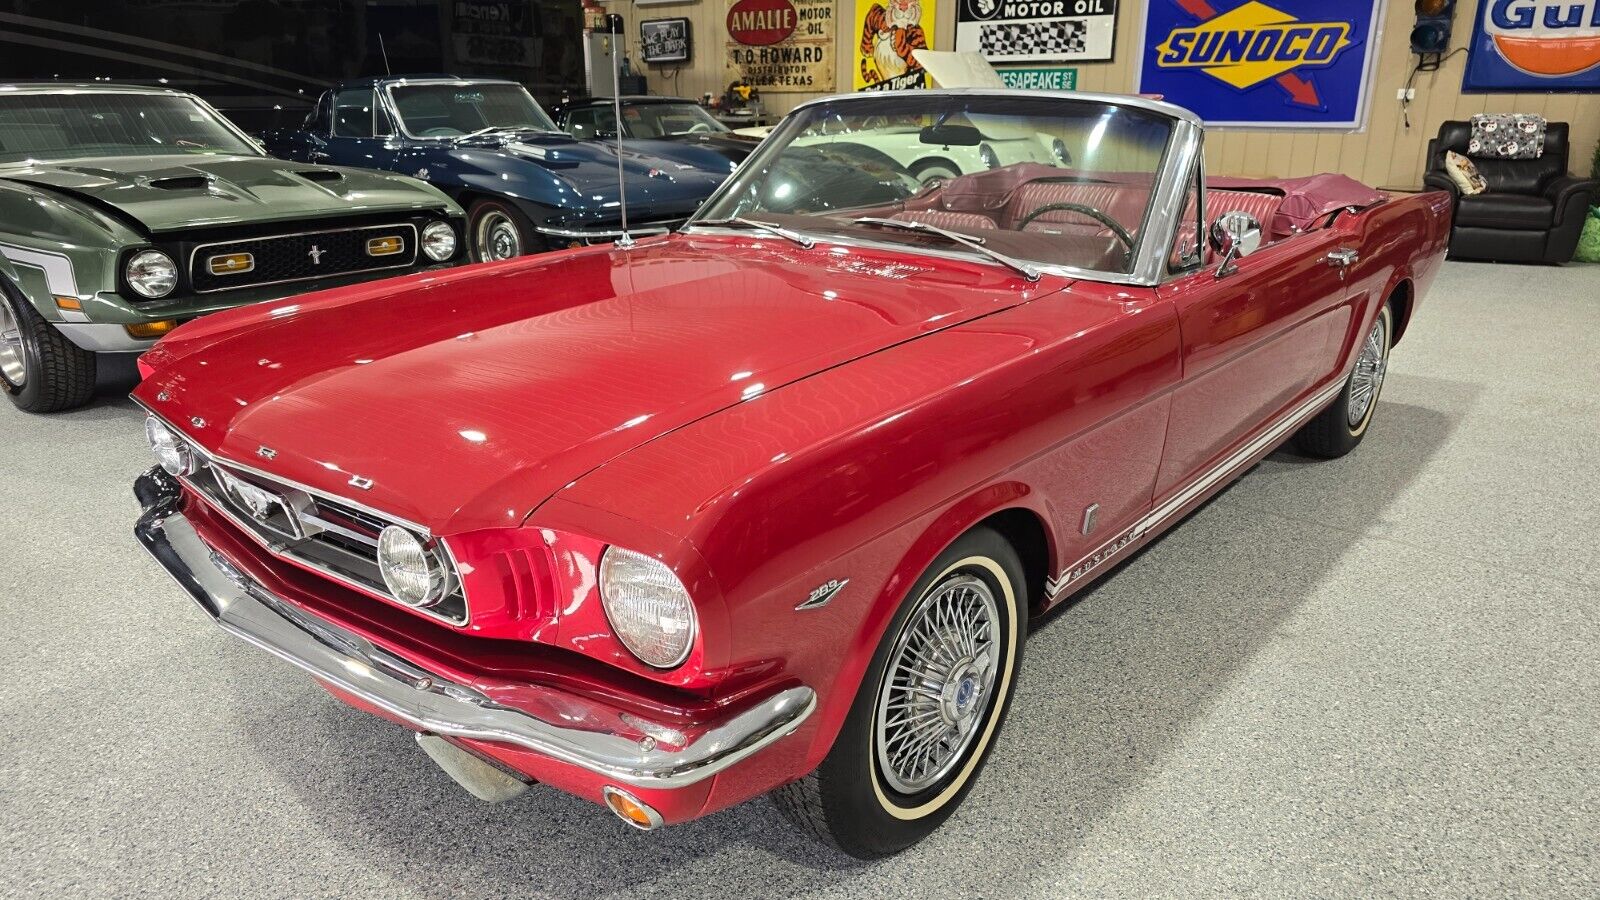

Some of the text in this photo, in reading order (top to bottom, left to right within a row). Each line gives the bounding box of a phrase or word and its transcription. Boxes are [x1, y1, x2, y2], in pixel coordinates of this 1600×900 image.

[800, 7, 832, 20] MOTOR
[1005, 0, 1104, 17] MOTOR OIL
[732, 9, 791, 31] AMALIE
[808, 22, 824, 35] OIL
[1162, 26, 1345, 63] SUNOCO
[760, 47, 823, 63] HOWARD
[748, 65, 807, 74] DISTRIBUTOR
[779, 76, 813, 86] TEXAS
[891, 73, 920, 90] Tiger
[1000, 72, 1073, 89] ESAPEAKE ST
[1062, 81, 1073, 89] SE
[1071, 532, 1136, 580] MUSTANG
[810, 579, 838, 602] 289
